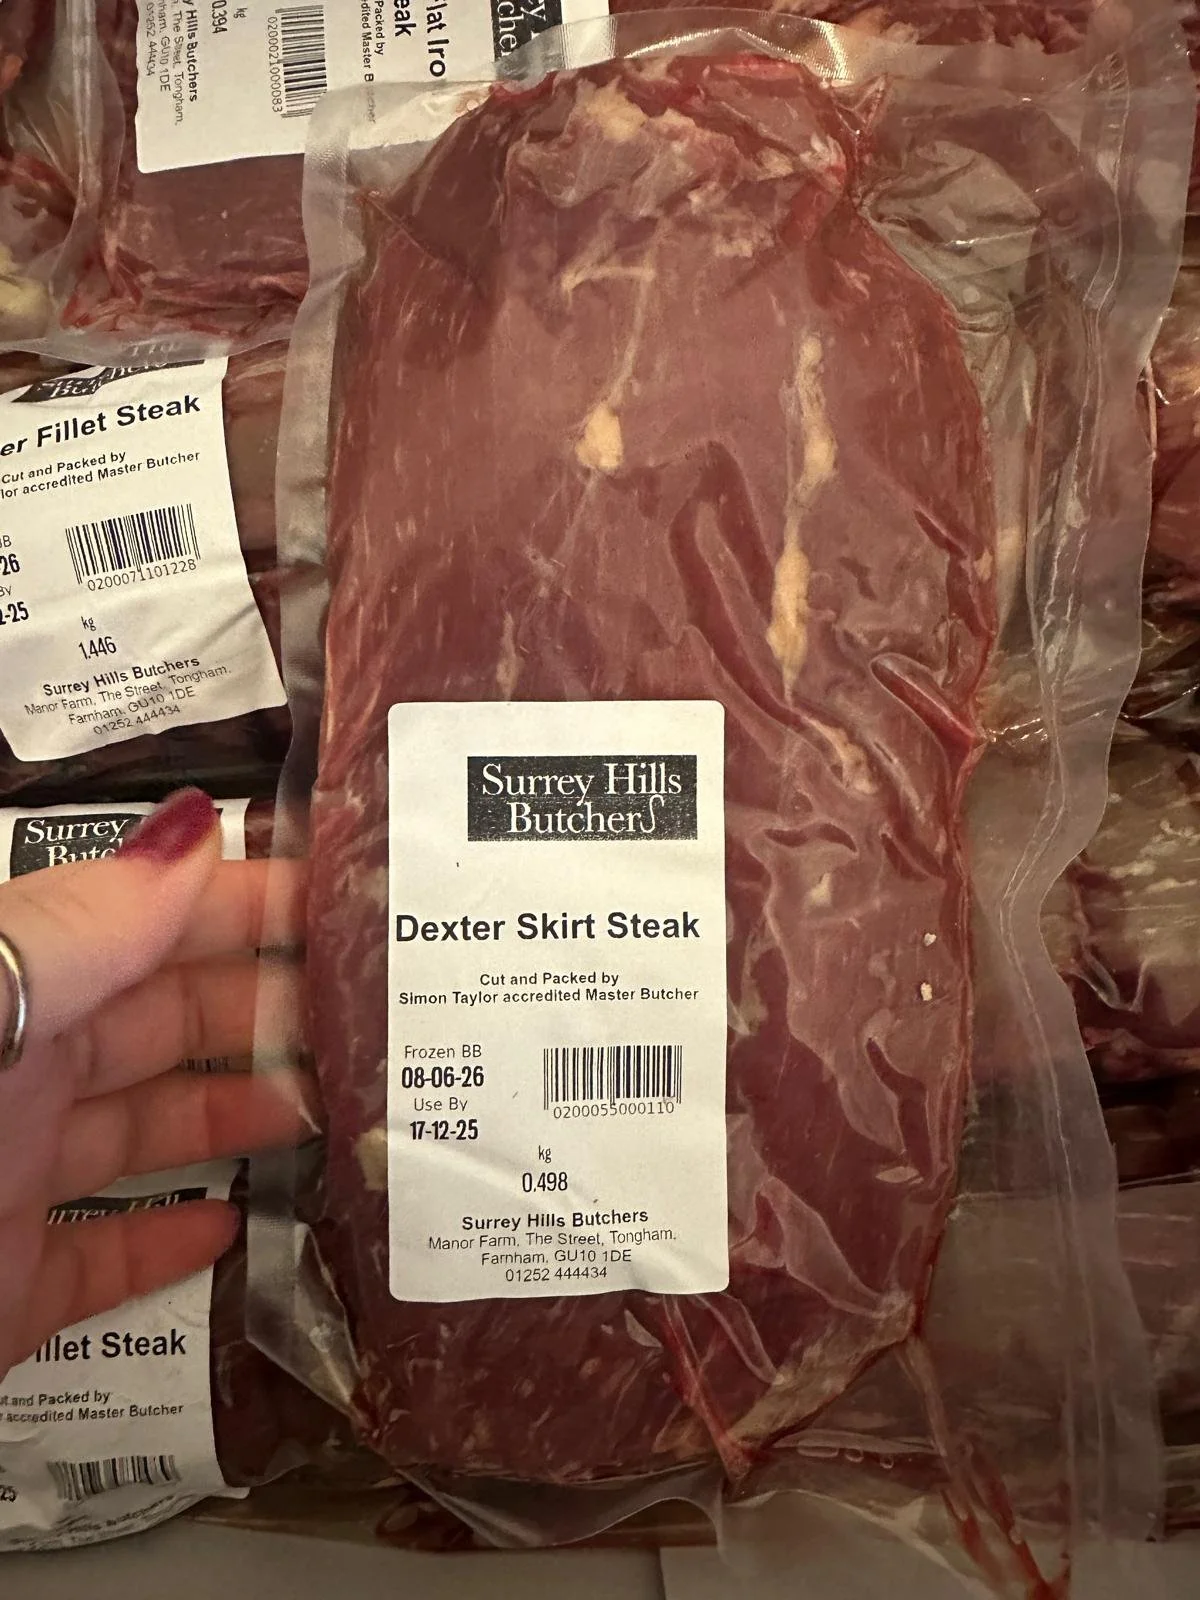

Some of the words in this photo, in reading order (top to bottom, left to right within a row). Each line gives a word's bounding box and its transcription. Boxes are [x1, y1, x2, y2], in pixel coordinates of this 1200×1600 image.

[186, 9, 198, 40] Hills
[361, 0, 371, 29] dited
[374, 0, 385, 39] Packed
[426, 0, 447, 33] lat
[362, 32, 373, 68] Master
[374, 42, 386, 55] by
[427, 39, 449, 77] Iro
[186, 41, 200, 102] Butchers
[0, 438, 28, 457] er
[37, 412, 107, 448] Fillet
[117, 395, 201, 427] Steak
[1, 472, 24, 484] Cut
[28, 464, 53, 479] and
[57, 454, 106, 473] Packed
[110, 451, 126, 464] by
[22, 471, 93, 495] accredited
[97, 461, 142, 481] Master
[146, 452, 200, 470] Butcher
[88, 559, 197, 592] 0200071101228
[81, 616, 97, 631] kg
[78, 636, 117, 660] 1.446
[43, 680, 90, 697] Surrey
[93, 669, 129, 687] Hills
[132, 656, 201, 679] Butchers
[99, 690, 122, 704] The
[169, 685, 196, 703] 1DE
[482, 763, 594, 806] Surrey
[603, 762, 682, 794] Hills
[506, 794, 665, 834] Butchers
[24, 819, 129, 844] Surrey
[396, 914, 505, 942] Dexter
[516, 912, 595, 940] Skirt
[606, 911, 701, 938] Steak
[479, 973, 505, 986] Cut
[509, 973, 538, 985] and
[542, 971, 597, 984] Packed
[601, 970, 619, 987] by
[398, 992, 447, 1005] Simon
[452, 991, 499, 1007] Taylor
[502, 989, 581, 1003] accredited
[585, 988, 635, 1001] Master
[640, 987, 700, 1001] Butcher
[404, 1045, 456, 1059] Frozen
[461, 1044, 482, 1058] BB
[401, 1065, 485, 1089] 08-06-26
[413, 1098, 442, 1112] Use
[448, 1097, 468, 1113] By
[552, 1100, 675, 1119] 0200055000110
[409, 1119, 479, 1141] 17-12-25
[538, 1145, 552, 1164] kg
[521, 1172, 568, 1193] 0.498
[461, 1216, 521, 1231] Surrey
[527, 1213, 566, 1228] Hills
[571, 1209, 649, 1228] Butchers
[429, 1236, 475, 1250] Manor
[525, 1232, 553, 1245] The
[554, 1249, 597, 1263] GU10
[602, 1249, 632, 1263] 1DE
[505, 1268, 550, 1283] 01252
[554, 1266, 608, 1280] 444434
[36, 1334, 91, 1363] illet
[101, 1328, 187, 1358] Steak
[11, 1394, 34, 1407] and
[38, 1390, 89, 1406] Packed
[94, 1389, 111, 1405] by
[78, 1404, 125, 1420] Master
[129, 1404, 184, 1418] Butcher
